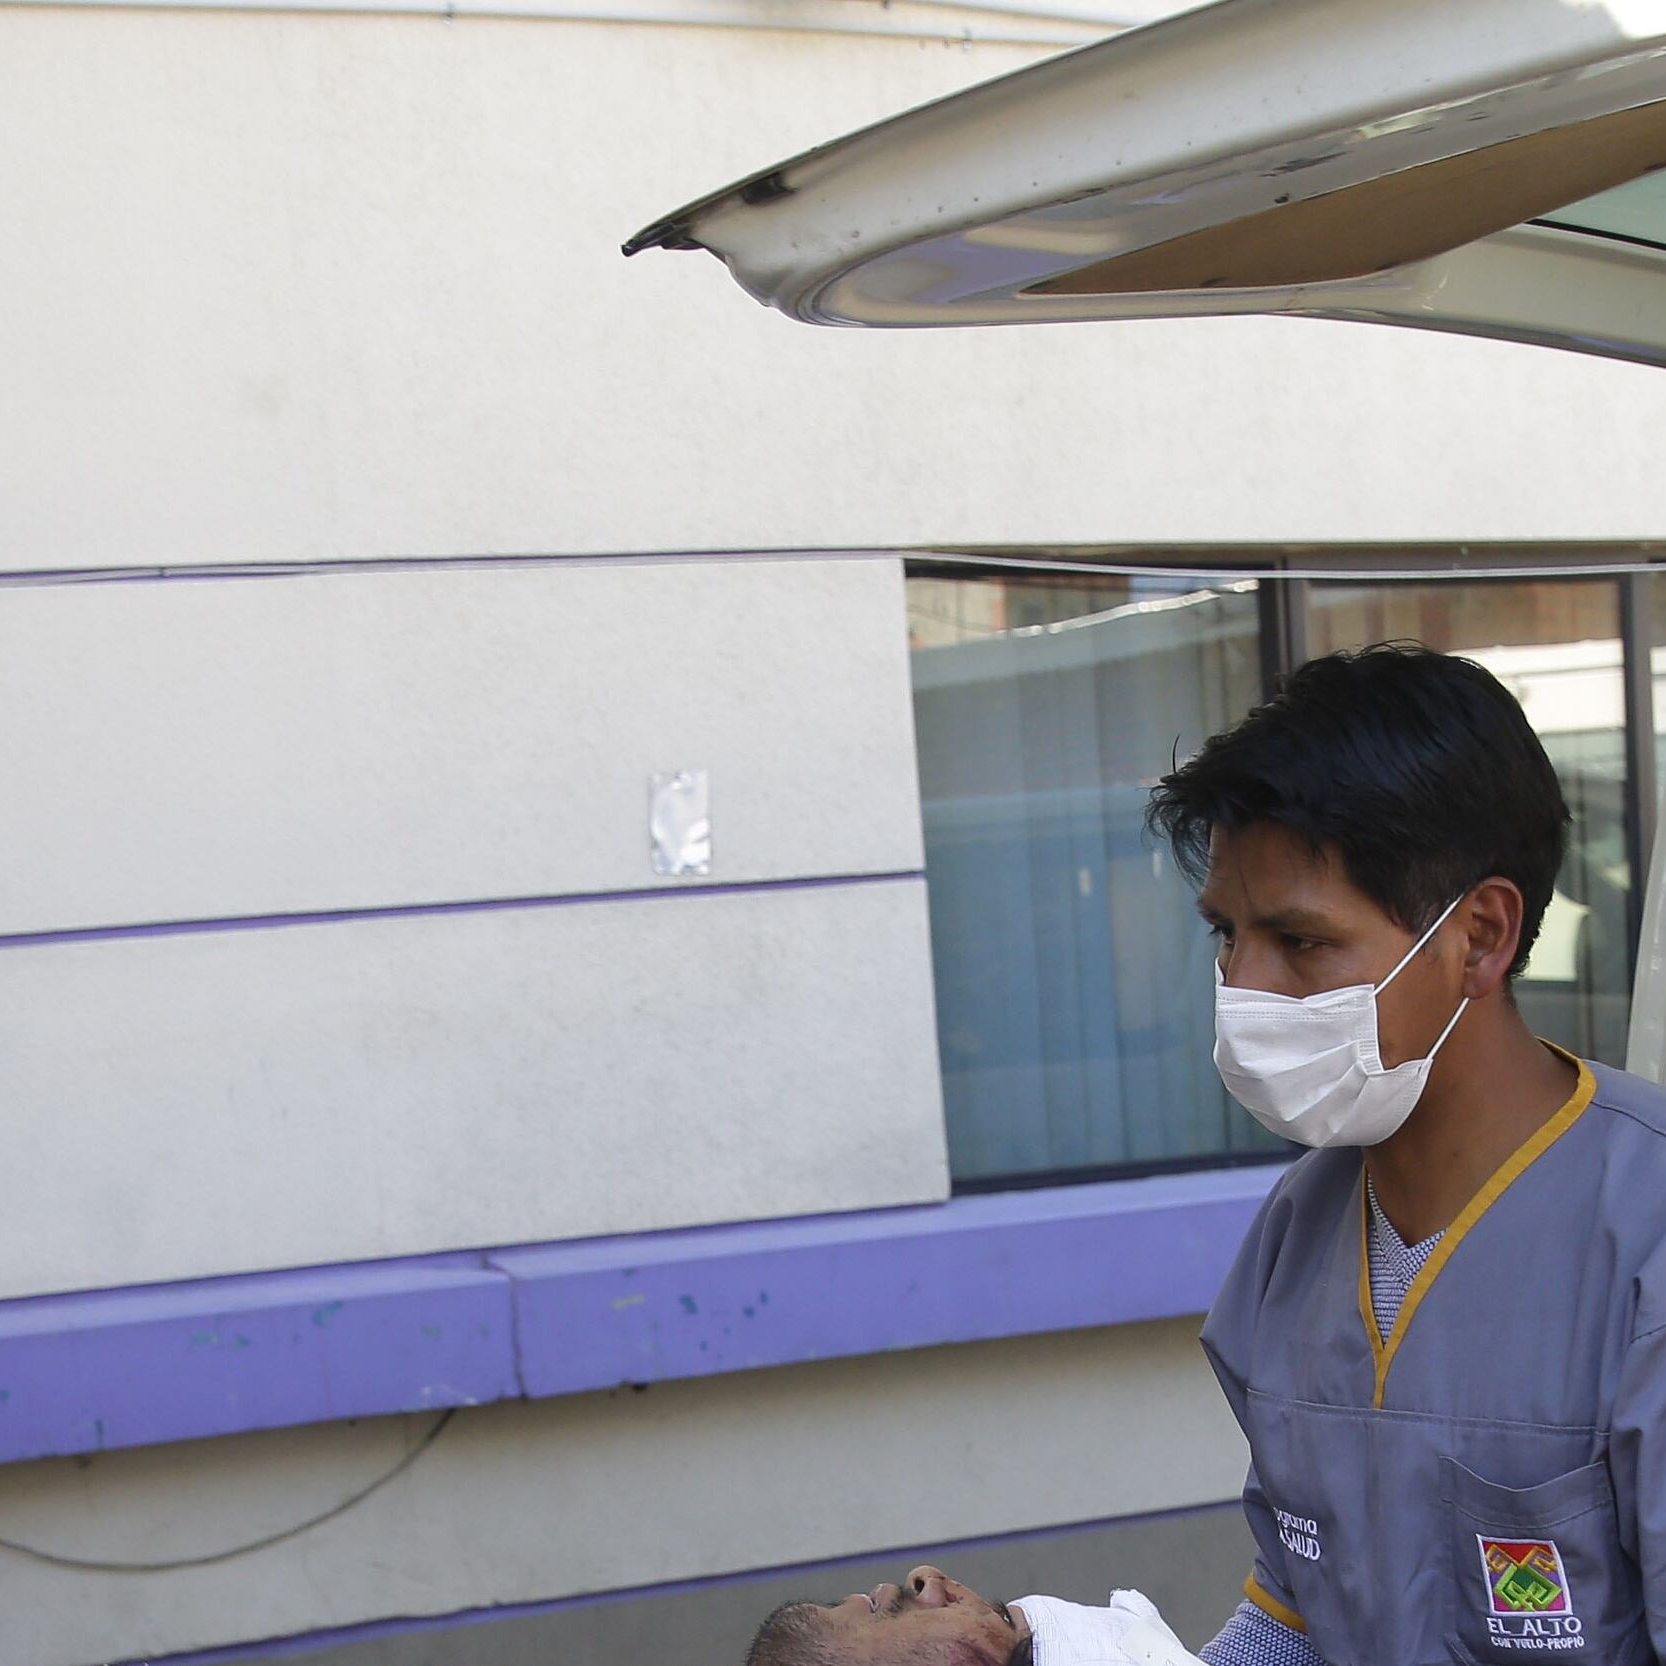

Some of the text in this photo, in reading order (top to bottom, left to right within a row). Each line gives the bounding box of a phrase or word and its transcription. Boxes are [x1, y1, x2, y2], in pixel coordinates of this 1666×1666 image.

[1486, 1616, 1582, 1637] EL ALTO
[1490, 1635, 1512, 1649] CON
[1547, 1635, 1585, 1650] PROPIO
